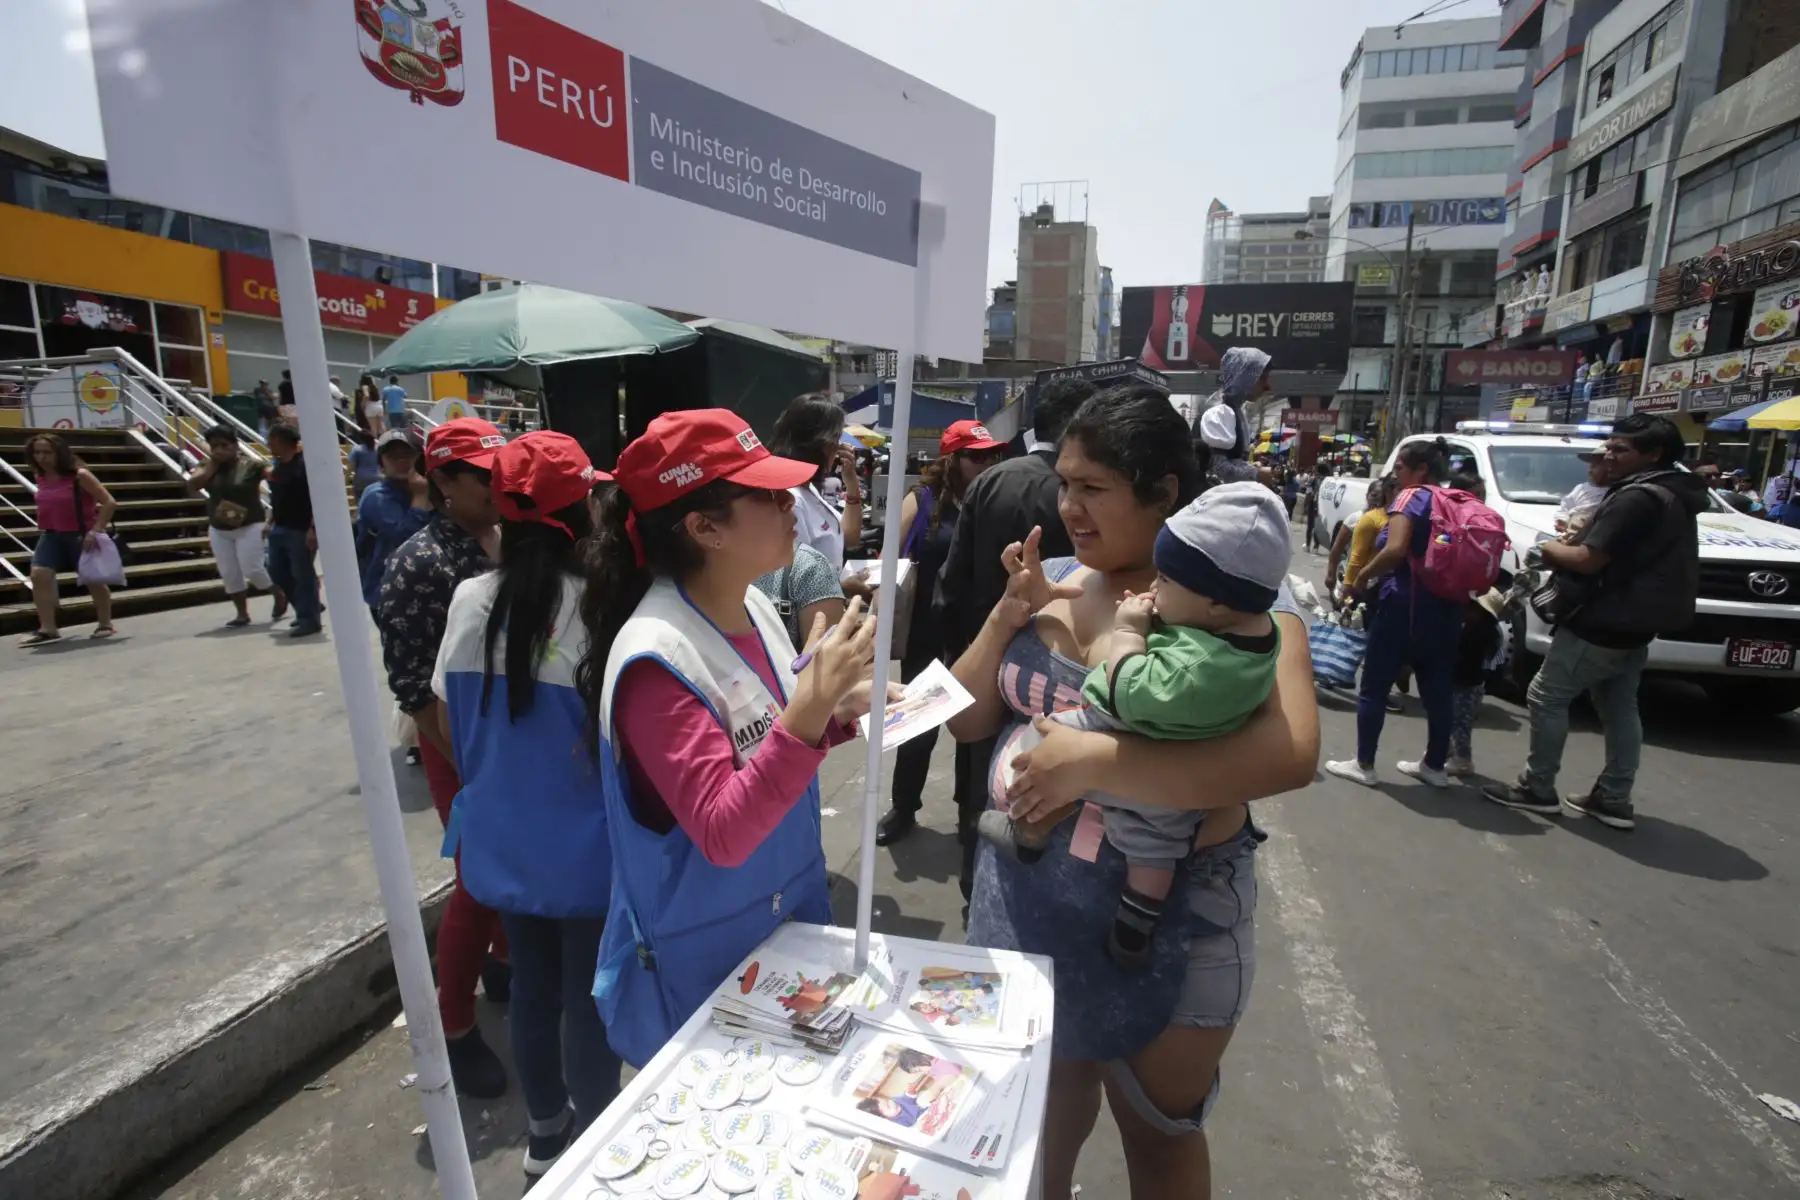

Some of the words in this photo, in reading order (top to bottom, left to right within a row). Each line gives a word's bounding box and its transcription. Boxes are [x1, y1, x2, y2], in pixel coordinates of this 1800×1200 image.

[508, 55, 614, 128] PERÚ
[1588, 81, 1673, 151] CORTINAS
[650, 112, 763, 175] Ministerio
[770, 158, 793, 185] de
[799, 168, 887, 217] Desarrollo
[651, 150, 665, 171] e
[674, 155, 767, 204] Inclusión
[774, 187, 827, 223] Social
[1236, 313, 1284, 337] REY
[1293, 312, 1335, 321] CIERRES
[1482, 357, 1563, 377] BAÑOS
[659, 464, 691, 484] CUNA
